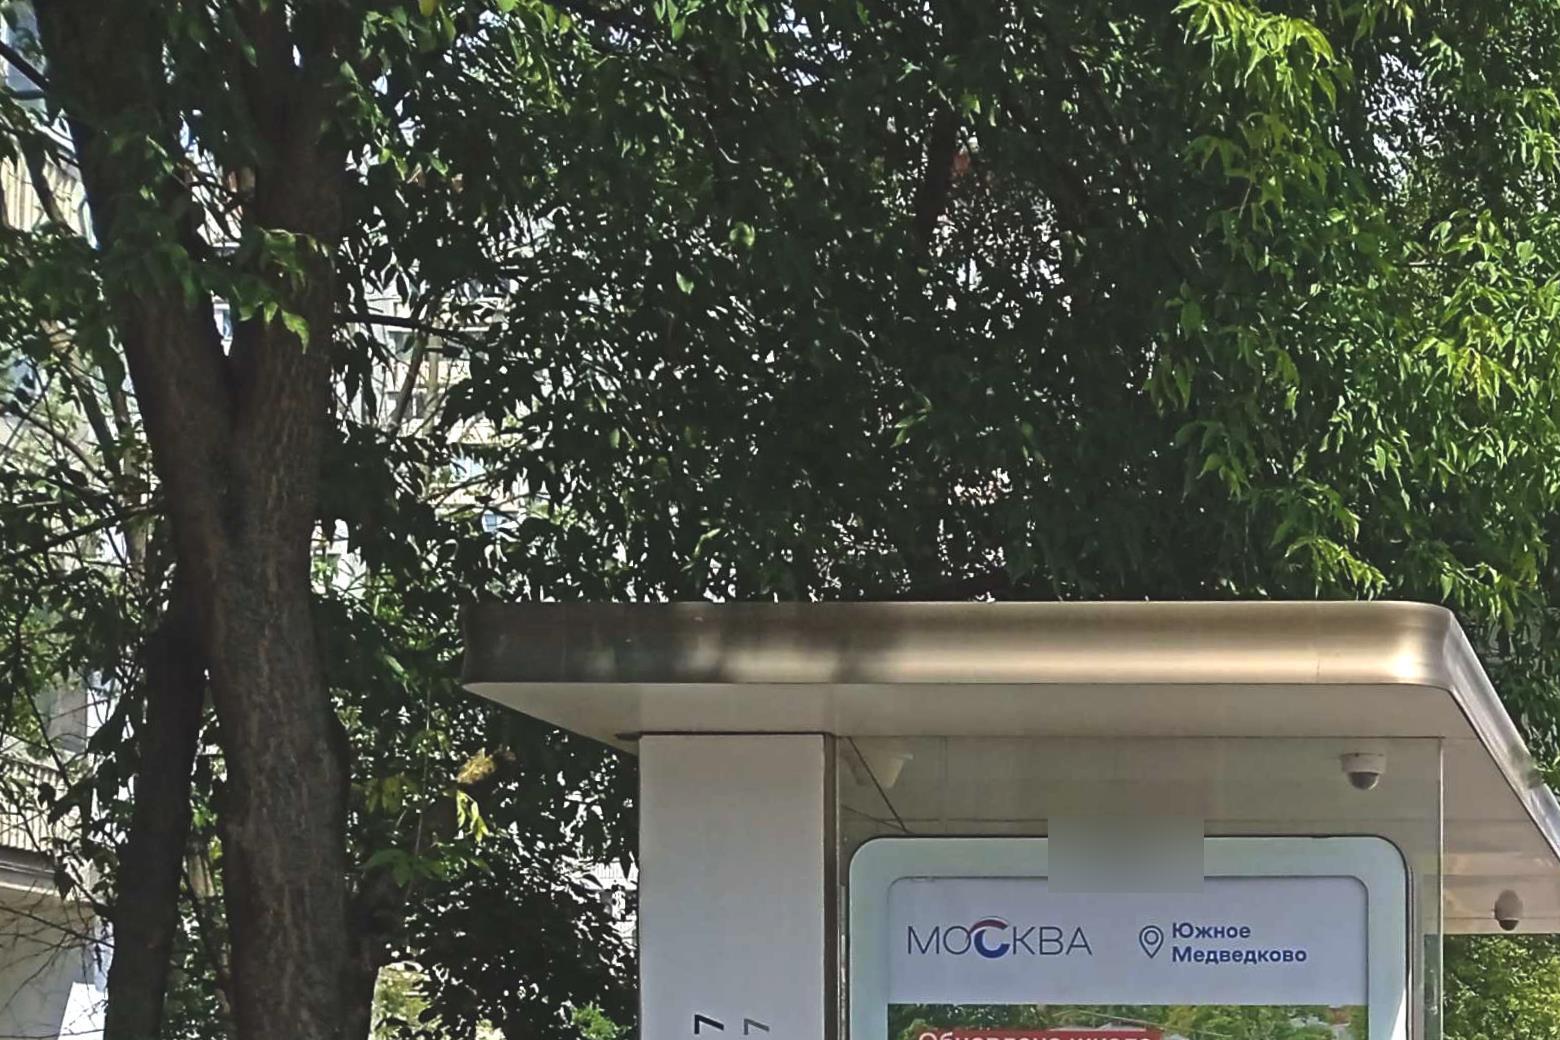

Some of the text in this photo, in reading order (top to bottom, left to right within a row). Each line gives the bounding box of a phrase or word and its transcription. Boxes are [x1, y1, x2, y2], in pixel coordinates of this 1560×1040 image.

[908, 916, 1093, 959] МОСКВА
[1171, 921, 1252, 940] Южное
[1171, 945, 1308, 965] Медведково
[693, 1013, 726, 1035] 7
[742, 1017, 770, 1036] 7
